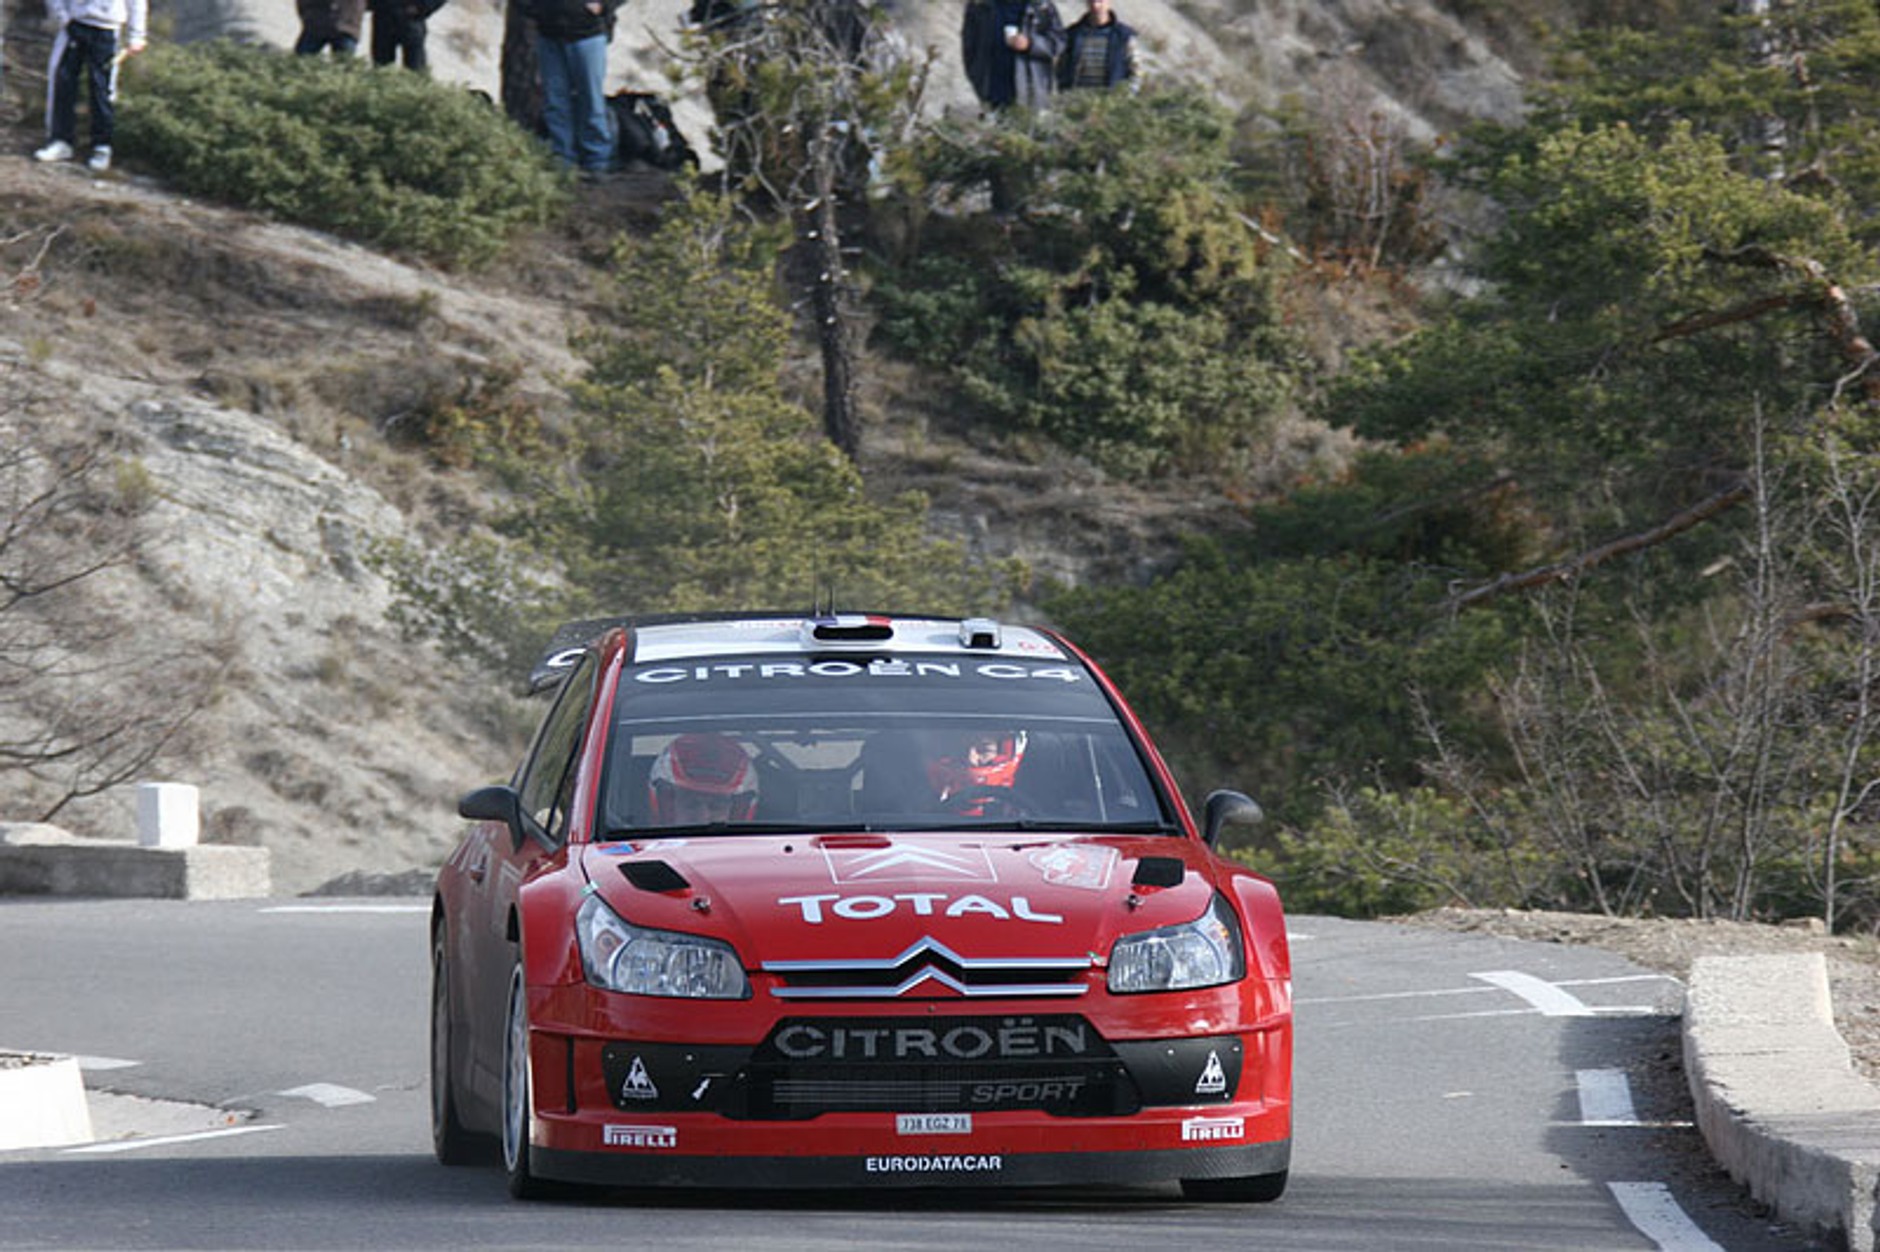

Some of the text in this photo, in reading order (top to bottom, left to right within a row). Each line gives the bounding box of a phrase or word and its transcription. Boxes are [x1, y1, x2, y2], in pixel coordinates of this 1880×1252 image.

[635, 658, 1080, 682] CITROËN C4
[778, 894, 1063, 923] TOTAL
[774, 1018, 1086, 1058] CITROËN
[971, 1082, 1085, 1103] SPORT
[604, 1124, 677, 1147] PIRELLI
[1182, 1117, 1244, 1140] PIRELLI
[866, 1156, 1002, 1172] EURODATACAR
